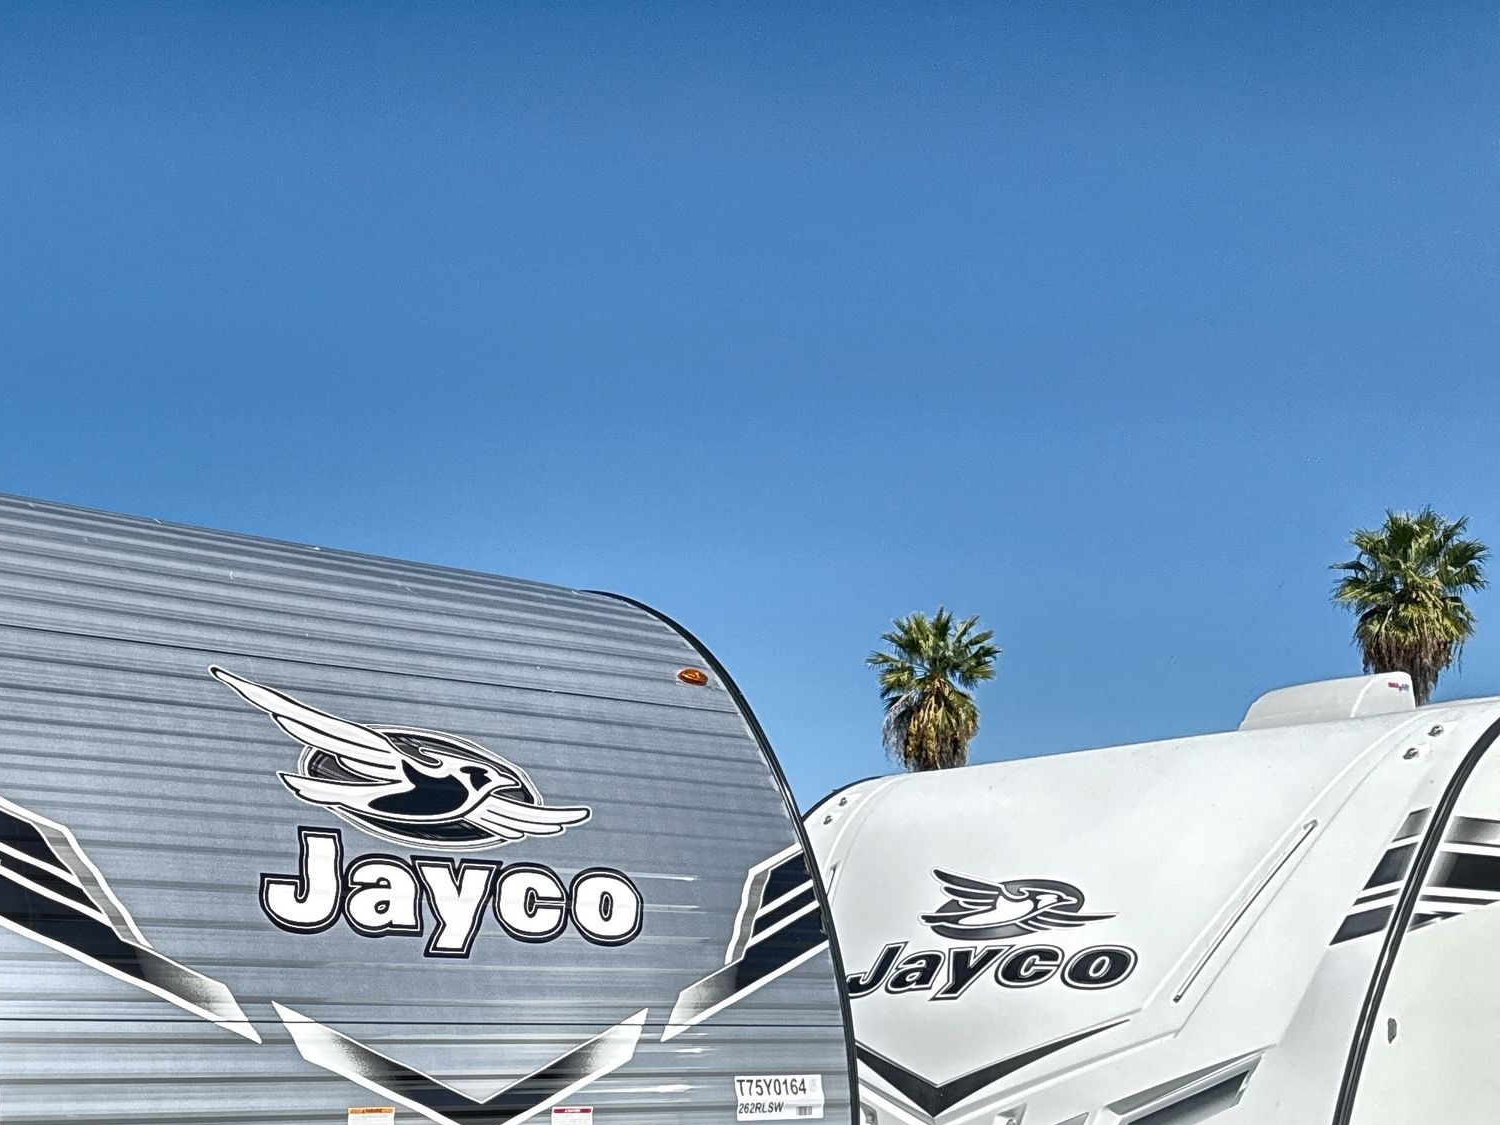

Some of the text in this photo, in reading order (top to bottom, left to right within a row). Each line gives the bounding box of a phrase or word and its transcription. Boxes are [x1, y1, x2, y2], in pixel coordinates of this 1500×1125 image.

[260, 826, 643, 958] Jayco
[846, 941, 1138, 1001] Jayco
[736, 1078, 807, 1096] T75Y0164
[738, 1101, 784, 1114] 262RLSW
